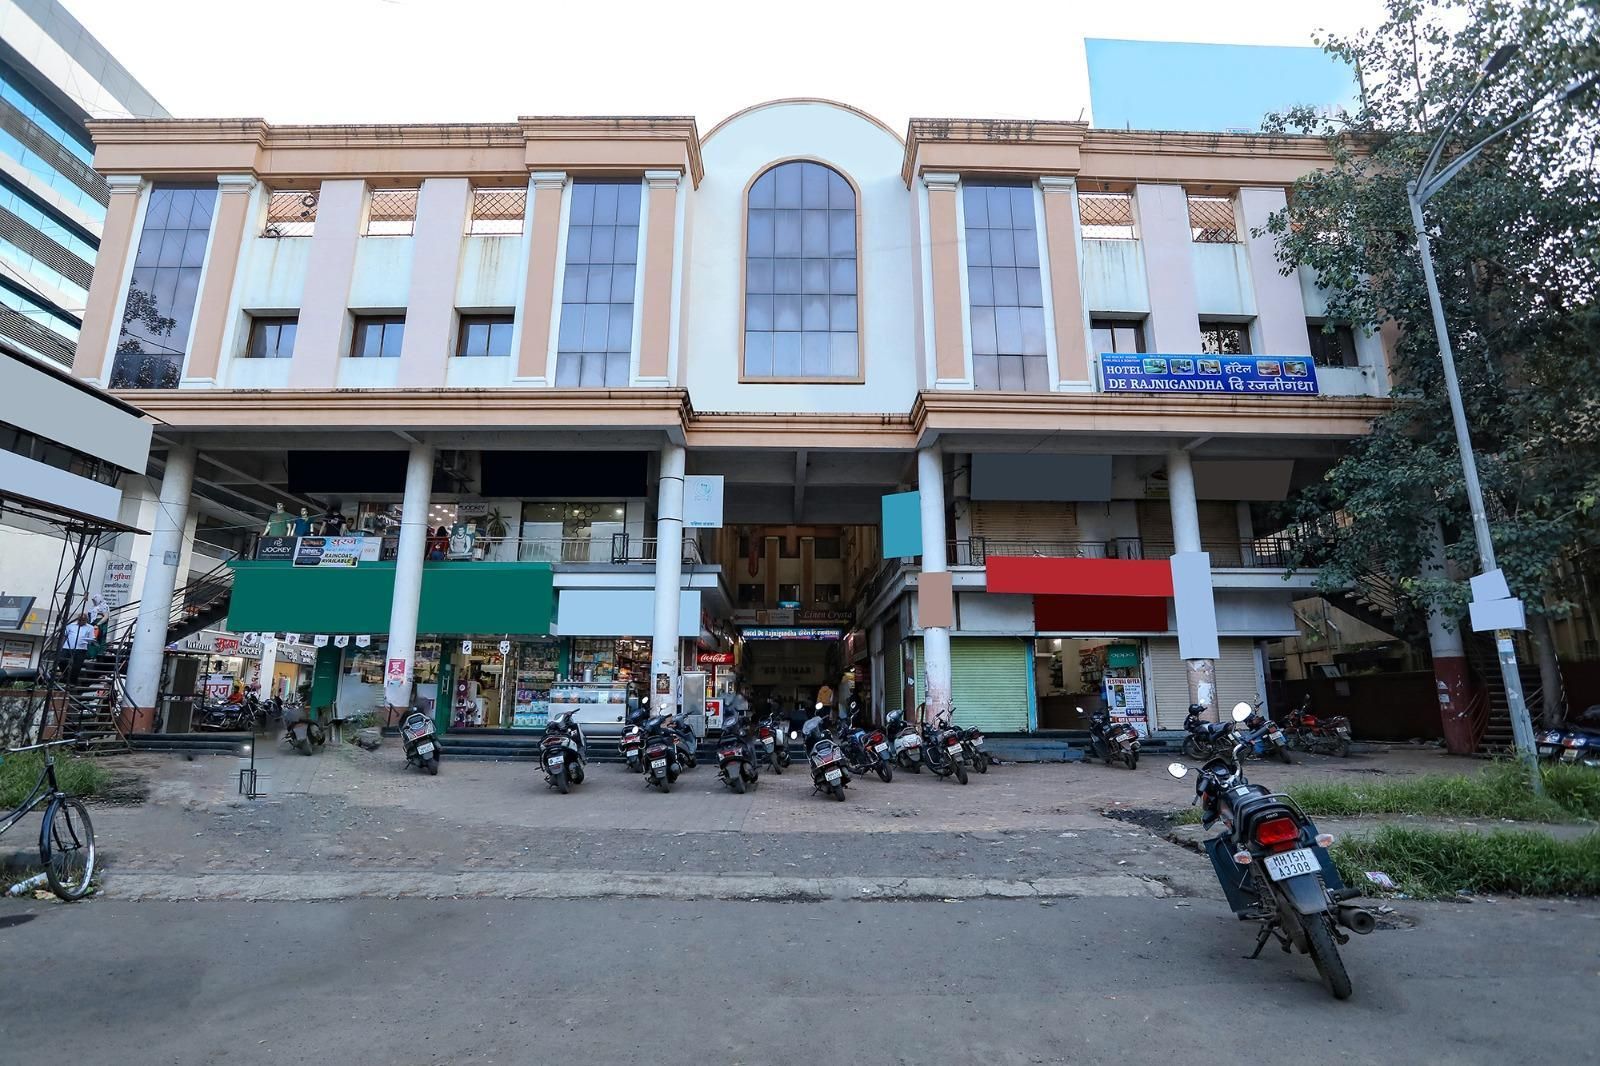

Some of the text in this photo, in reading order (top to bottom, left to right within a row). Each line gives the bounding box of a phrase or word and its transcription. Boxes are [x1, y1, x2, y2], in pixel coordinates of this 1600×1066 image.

[1106, 365, 1143, 375] HOTEL
[1224, 361, 1252, 374] हॉटेल
[1108, 378, 1225, 390] DE RAJNIGANDHA
[1228, 376, 1314, 391] दि रजनीगंधा
[240, 647, 263, 656] JOCKEY
[1272, 851, 1307, 867] MH15H
[1279, 861, 1311, 877] A3308
